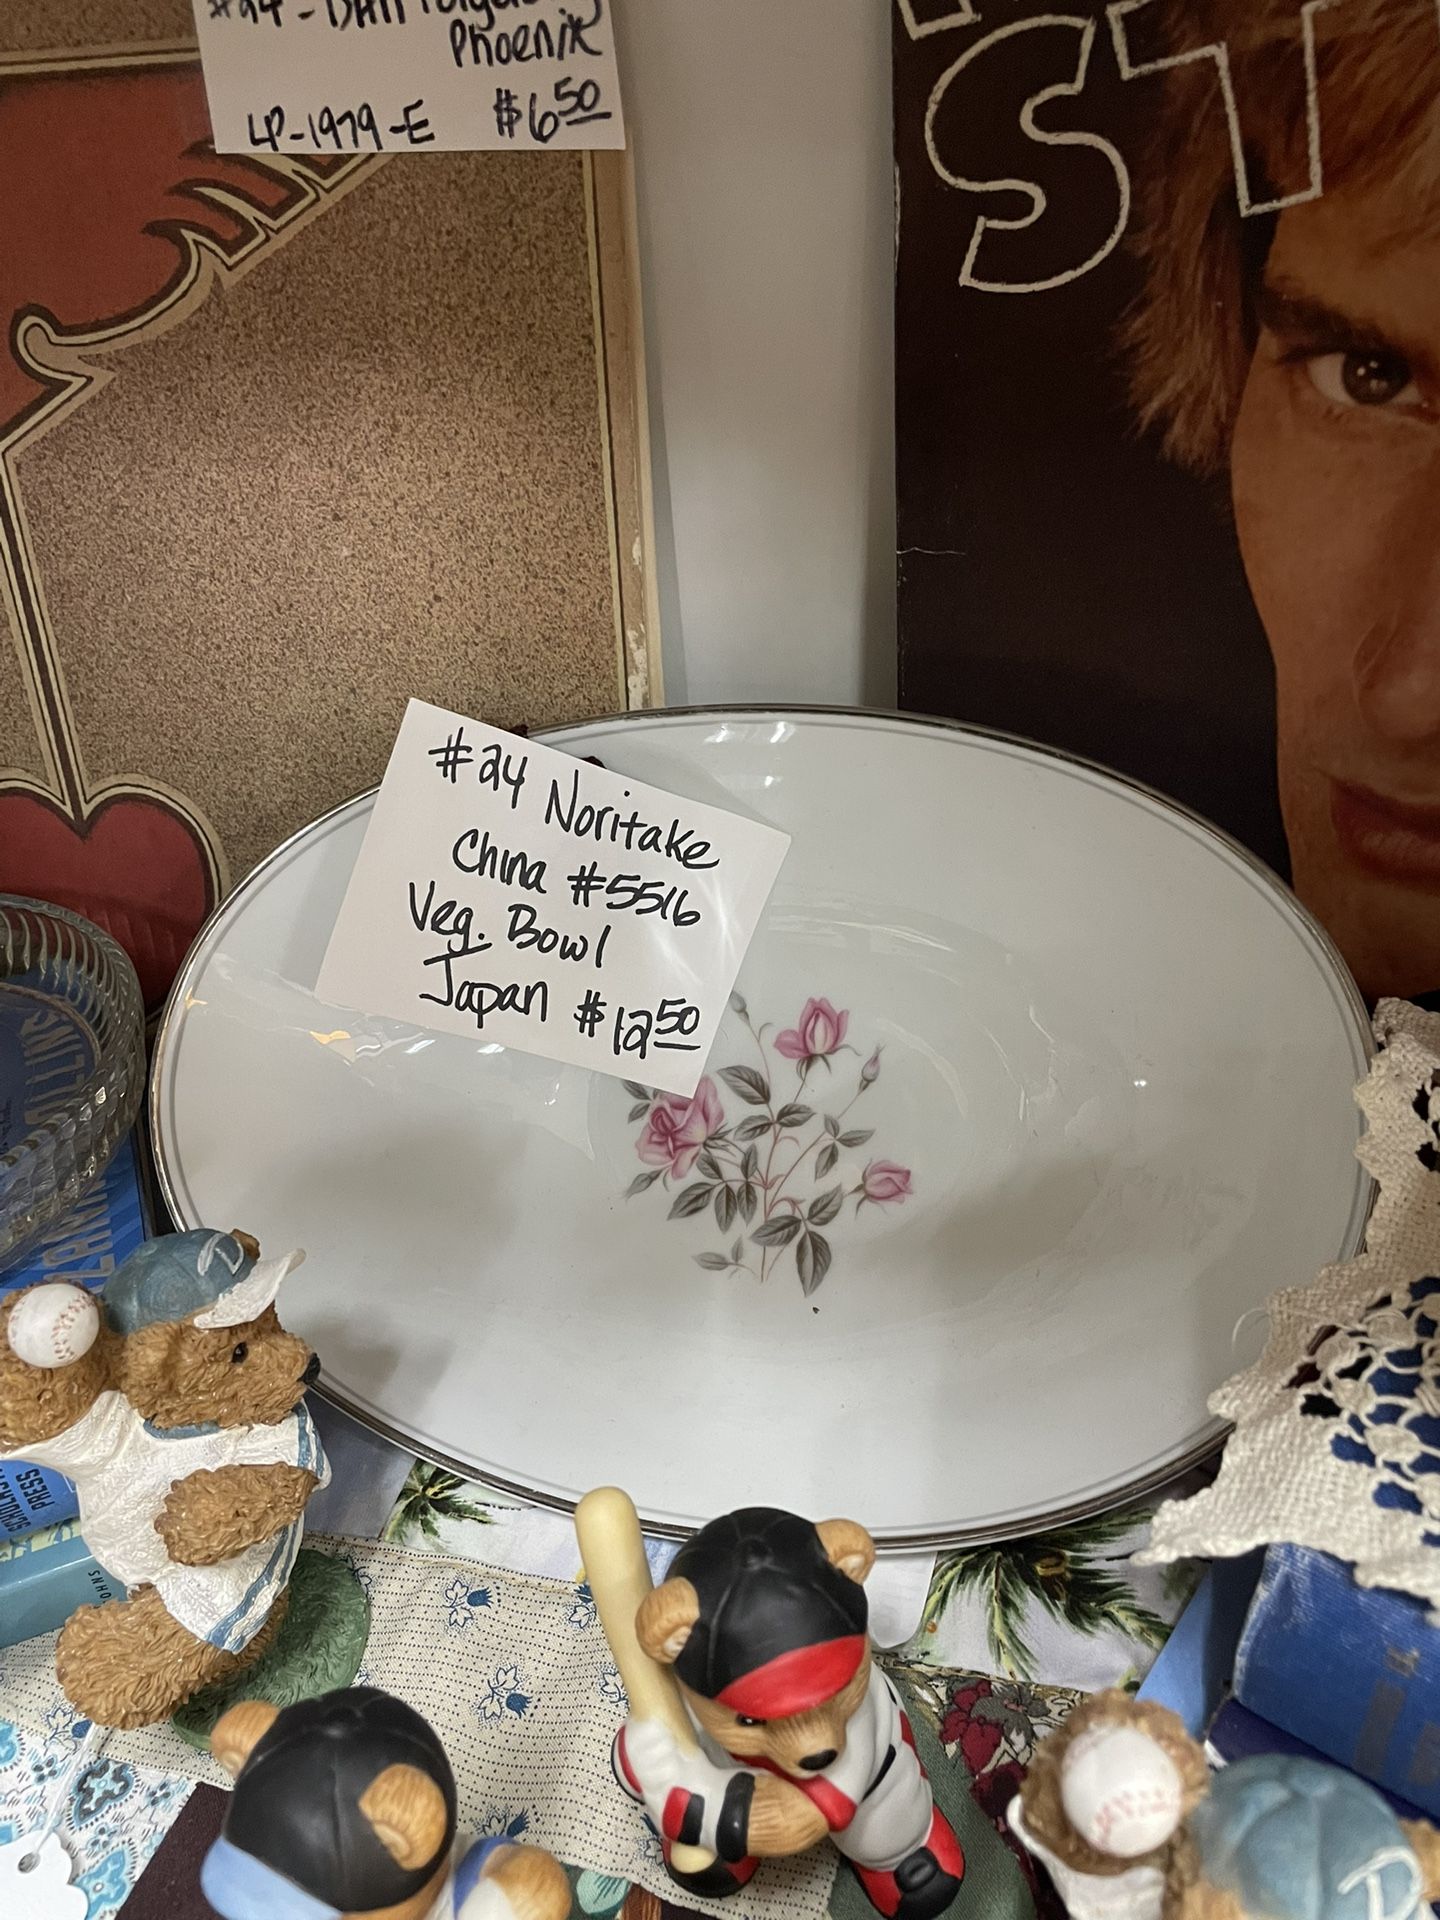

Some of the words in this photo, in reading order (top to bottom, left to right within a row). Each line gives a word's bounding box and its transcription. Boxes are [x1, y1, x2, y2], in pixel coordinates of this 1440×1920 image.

[428, 726, 528, 809] #24
[544, 769, 720, 869] Noritake
[452, 829, 547, 894] China
[566, 862, 701, 927] #5516
[409, 880, 488, 954] Veg.
[507, 904, 612, 968] Bowl
[419, 944, 548, 1028] Japan
[15, 1468, 55, 1511] PRESS
[87, 1569, 112, 1609] OHNS
